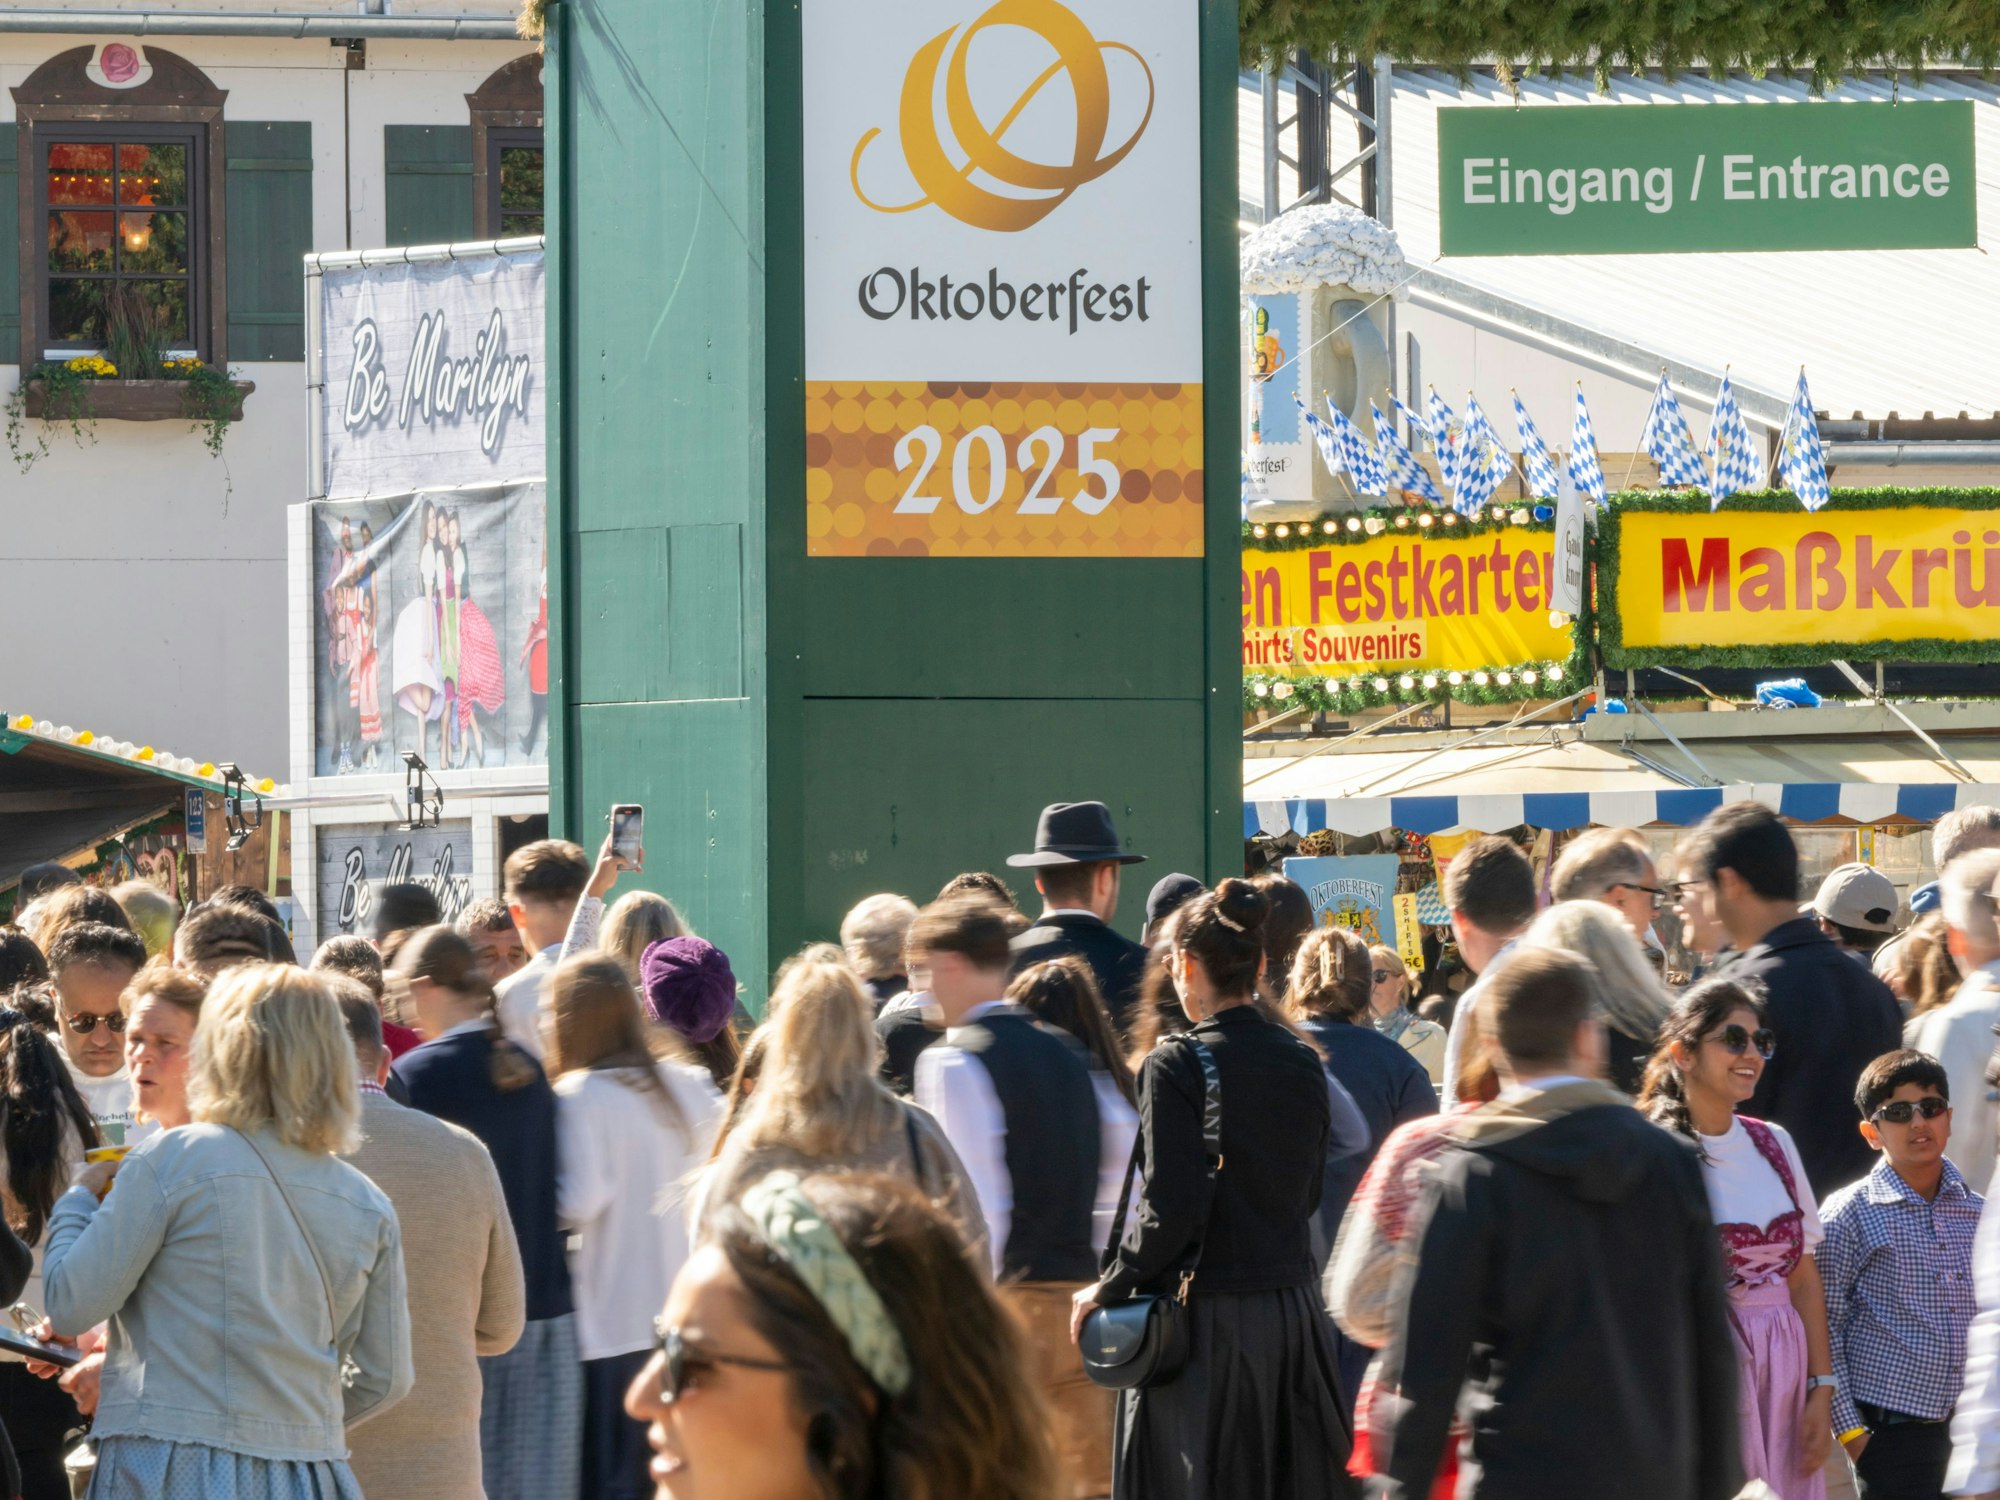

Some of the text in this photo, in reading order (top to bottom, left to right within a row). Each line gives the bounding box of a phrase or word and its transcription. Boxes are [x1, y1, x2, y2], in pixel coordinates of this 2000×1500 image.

[1463, 154, 1950, 215] Eingang / Entrance
[858, 266, 1152, 336] Oktoberfest
[344, 307, 530, 456] Be Marilyn
[893, 424, 1121, 515] 2025
[1303, 625, 1422, 663] Souvenirs
[189, 797, 202, 816] 123
[338, 846, 371, 927] Be
[1310, 879, 1383, 912] OKTOBERFEST
[1402, 897, 1409, 907] 2
[1405, 957, 1421, 968] 5€
